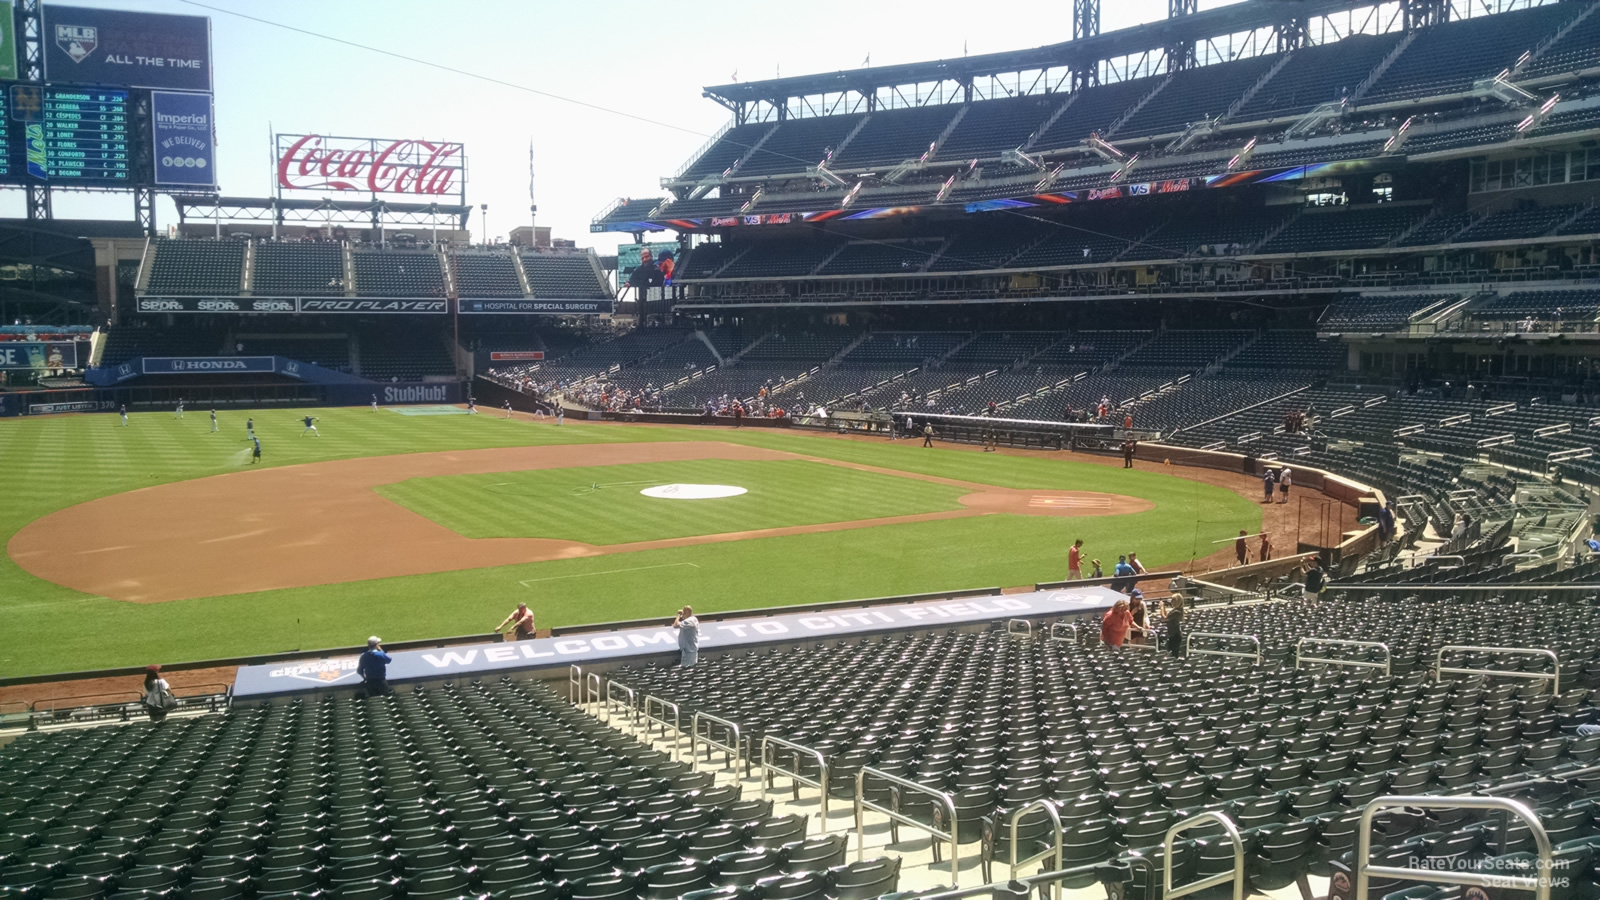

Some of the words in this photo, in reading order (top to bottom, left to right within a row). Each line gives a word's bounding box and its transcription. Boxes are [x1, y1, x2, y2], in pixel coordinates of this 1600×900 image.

[58, 26, 95, 39] MLB
[105, 54, 133, 65] ALL
[135, 56, 164, 67] THE
[167, 58, 201, 69] TIME
[157, 112, 207, 125] Imperial
[161, 137, 174, 149] WE
[174, 136, 206, 151] DELIVER
[277, 134, 463, 195] Coca-Cola
[1131, 185, 1148, 195] VS
[302, 301, 354, 310] PRO
[354, 301, 445, 310] PLAYER
[484, 302, 518, 310] HOSPITAL
[518, 302, 532, 310] FOR
[187, 361, 247, 369] HONDA
[384, 385, 447, 402] StubHub!
[421, 630, 710, 668] WELCOM
[718, 620, 789, 638] TO
[798, 610, 894, 628] CITI
[899, 598, 1032, 620] FIELD
